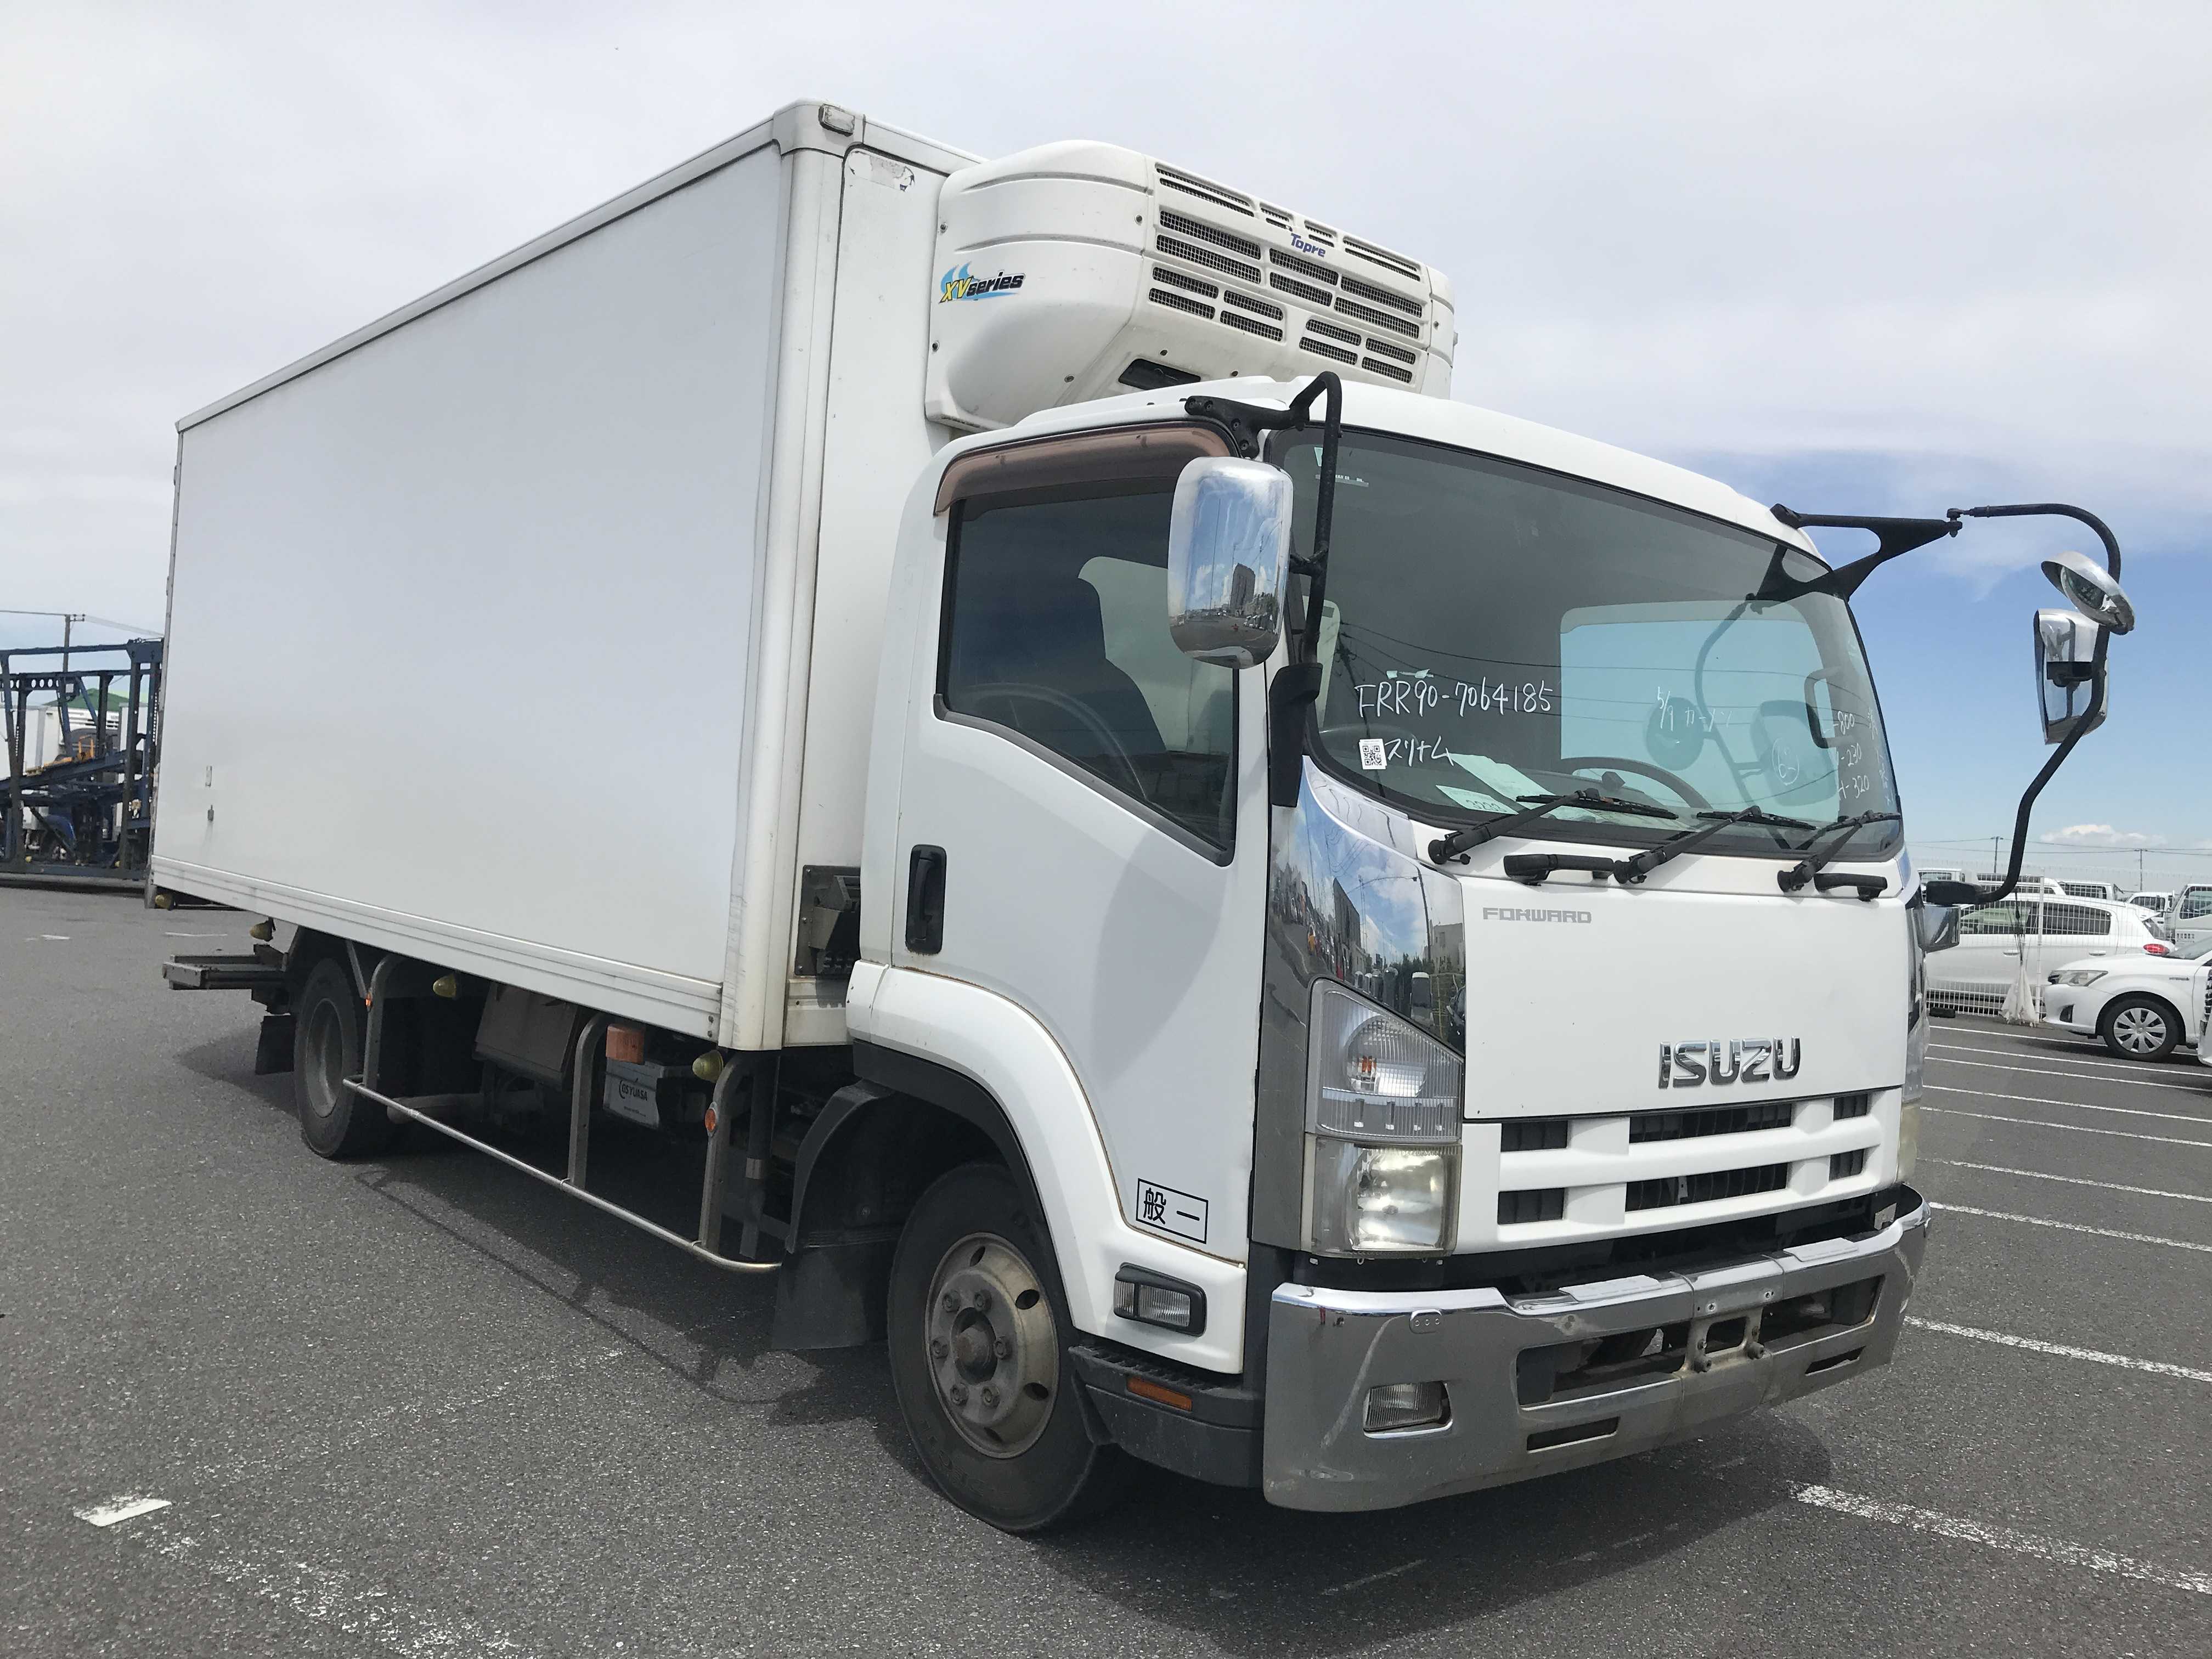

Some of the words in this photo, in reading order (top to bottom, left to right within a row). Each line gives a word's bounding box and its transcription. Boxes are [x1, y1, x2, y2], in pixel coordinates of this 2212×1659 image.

[1290, 232, 1326, 258] Topre
[1355, 676, 1553, 718] FRR90-7064185
[1482, 907, 1592, 924] FORWARD
[1658, 1035, 1801, 1090] ISUZU
